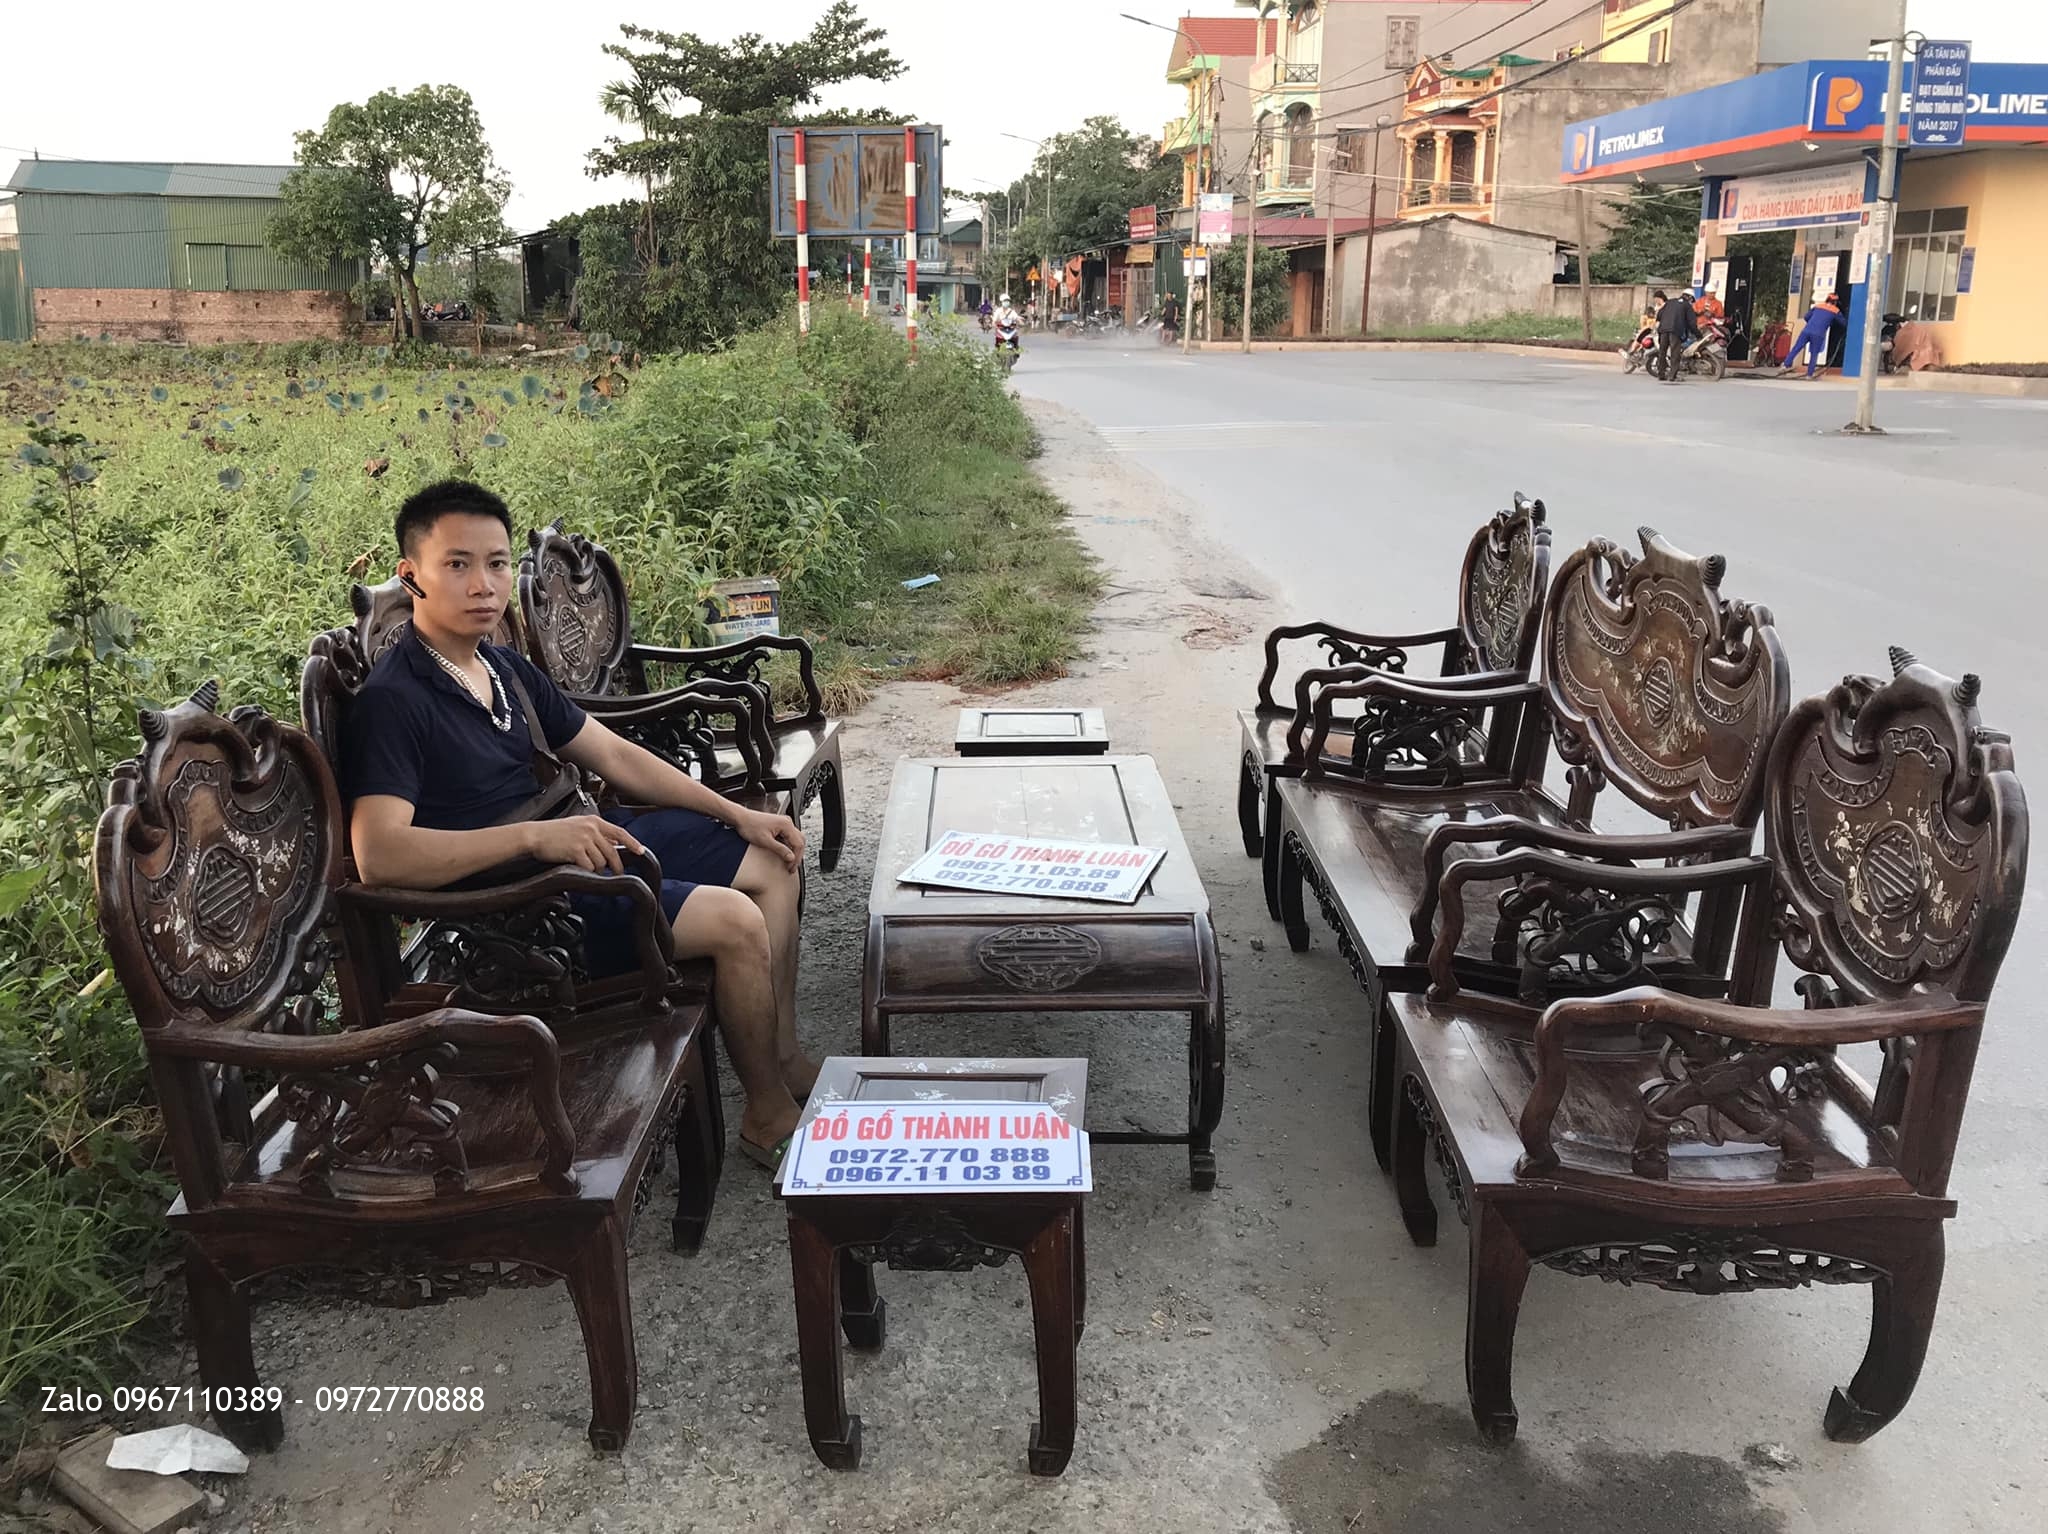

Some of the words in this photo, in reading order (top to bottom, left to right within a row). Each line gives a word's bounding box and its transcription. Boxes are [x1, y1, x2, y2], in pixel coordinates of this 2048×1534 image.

[1938, 120, 1958, 131] 2017
[1599, 126, 1665, 156] PETROLIMEX
[939, 837, 976, 858] ĐỒ
[1010, 843, 1083, 865] THÀNH
[1083, 846, 1149, 868] LUÂN
[943, 858, 1121, 880] 0967.11.03.89
[934, 869, 1109, 893] 0972.770.888
[811, 1109, 849, 1141] ĐỒ
[857, 1109, 897, 1141] GỖ
[902, 1112, 990, 1140] THÀNH
[1000, 1112, 1070, 1140] LUÂN
[829, 1147, 979, 1164] 0972.770
[990, 1147, 1050, 1163] 888
[825, 1165, 948, 1183] 0967.11
[963, 1165, 1001, 1182] 03
[1012, 1165, 1050, 1181] 89
